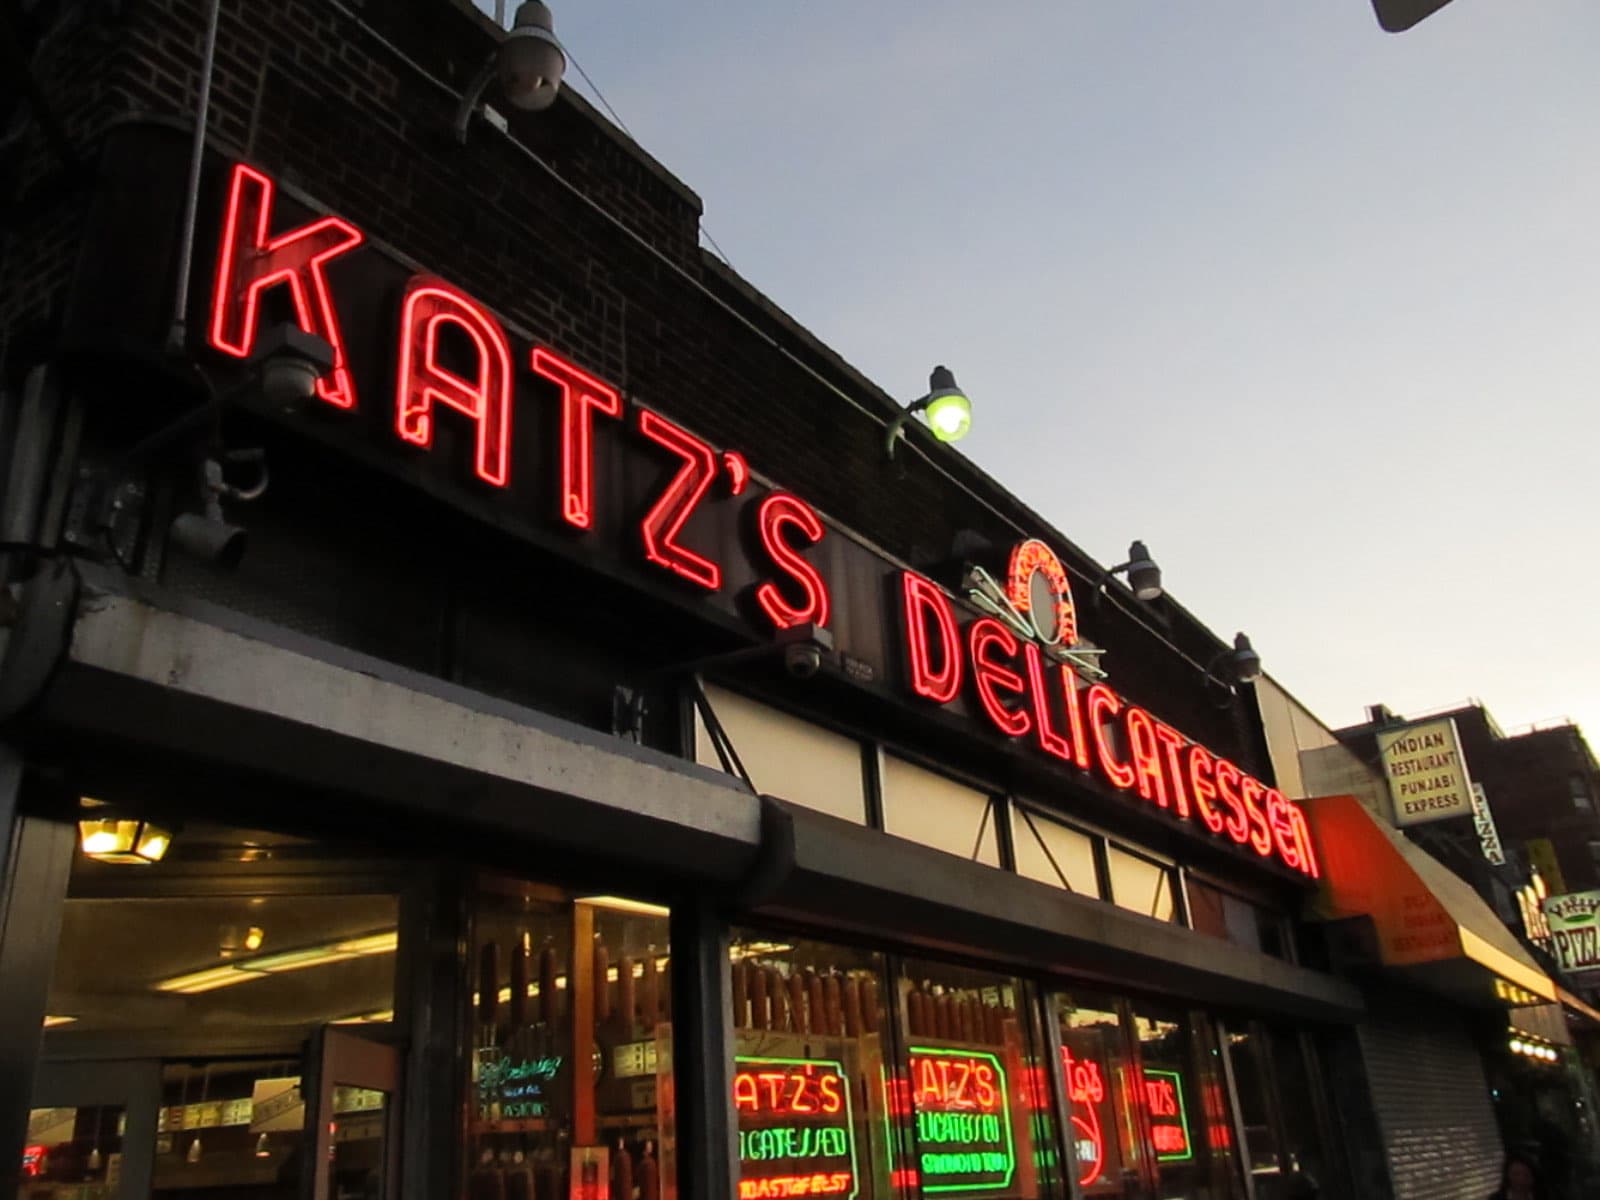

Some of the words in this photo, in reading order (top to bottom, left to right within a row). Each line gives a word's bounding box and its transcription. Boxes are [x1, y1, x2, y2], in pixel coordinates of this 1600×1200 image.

[209, 163, 829, 630] KATZ'S
[1391, 732, 1445, 756] INDIAN
[1390, 751, 1457, 777] RESTAURANT
[1400, 775, 1457, 796] PUNJABI
[1404, 793, 1460, 815] EXPRESS
[1552, 925, 1600, 969] PIZZ
[734, 1063, 841, 1113] ATZ'S
[910, 1058, 996, 1107] ATZ'S
